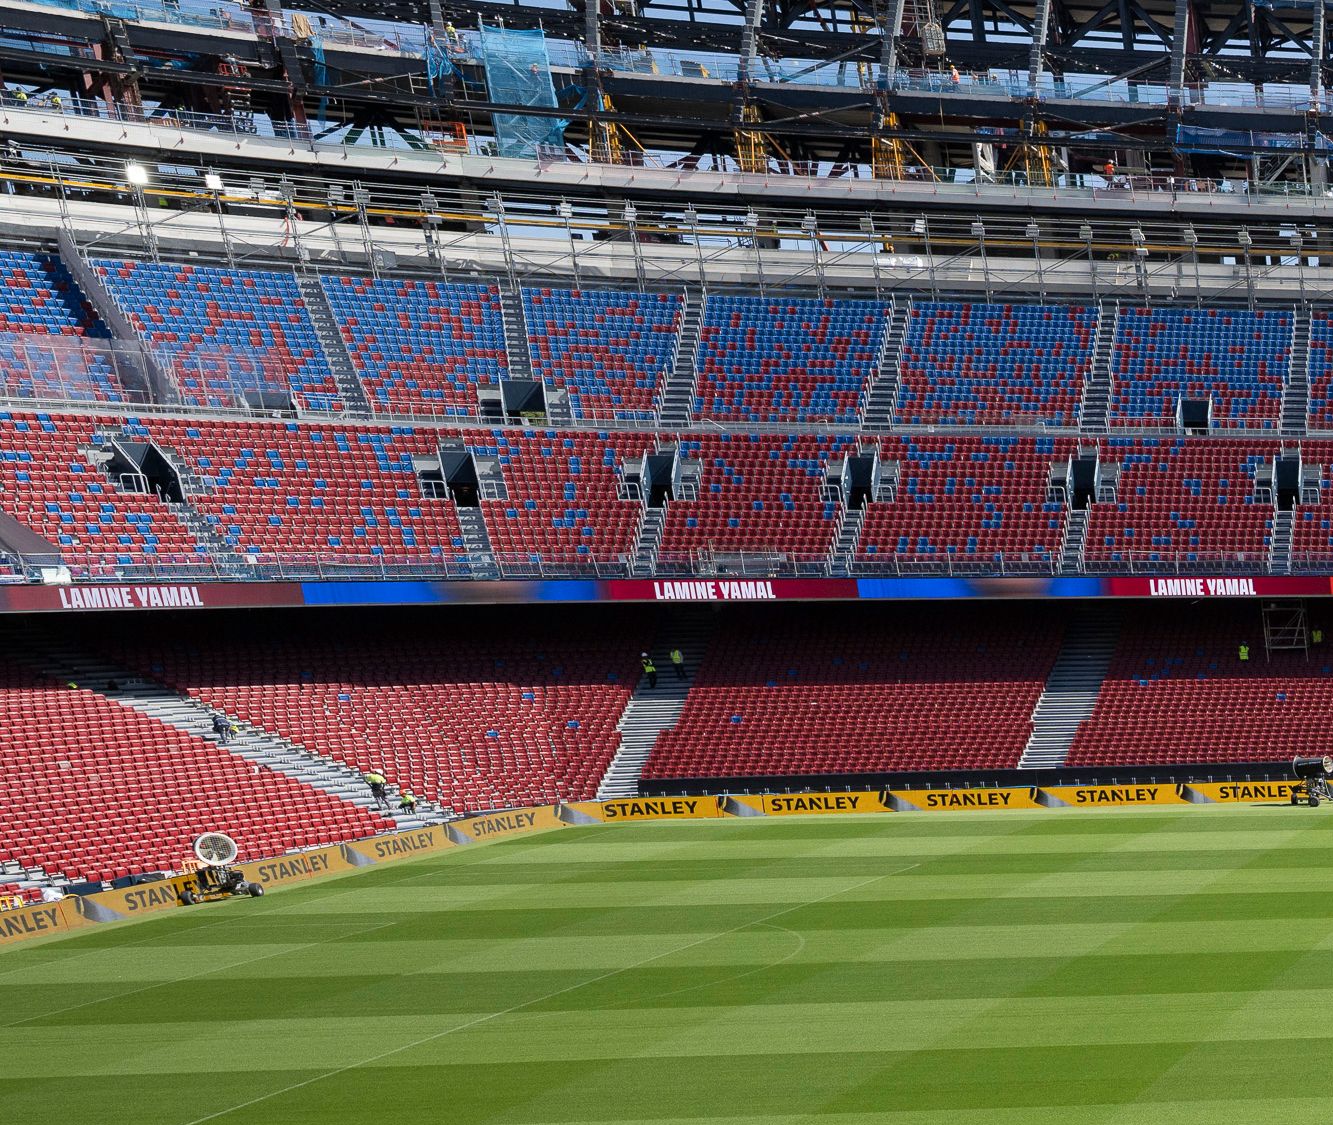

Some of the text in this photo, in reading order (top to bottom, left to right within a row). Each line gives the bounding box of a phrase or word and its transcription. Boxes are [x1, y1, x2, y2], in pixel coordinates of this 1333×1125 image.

[654, 582, 776, 599] LAMINE YAMAL
[1150, 579, 1256, 595] LAMINE YAMAL
[59, 587, 204, 608] LAMINE YAMAL
[772, 796, 859, 811] STANLEY
[927, 793, 1010, 806] STANLEY
[1076, 789, 1158, 802] STANLEY
[605, 801, 697, 817] STANLEY
[473, 813, 536, 837] STANLEY
[375, 832, 434, 857] STANLEY
[258, 854, 328, 883] STANLEY
